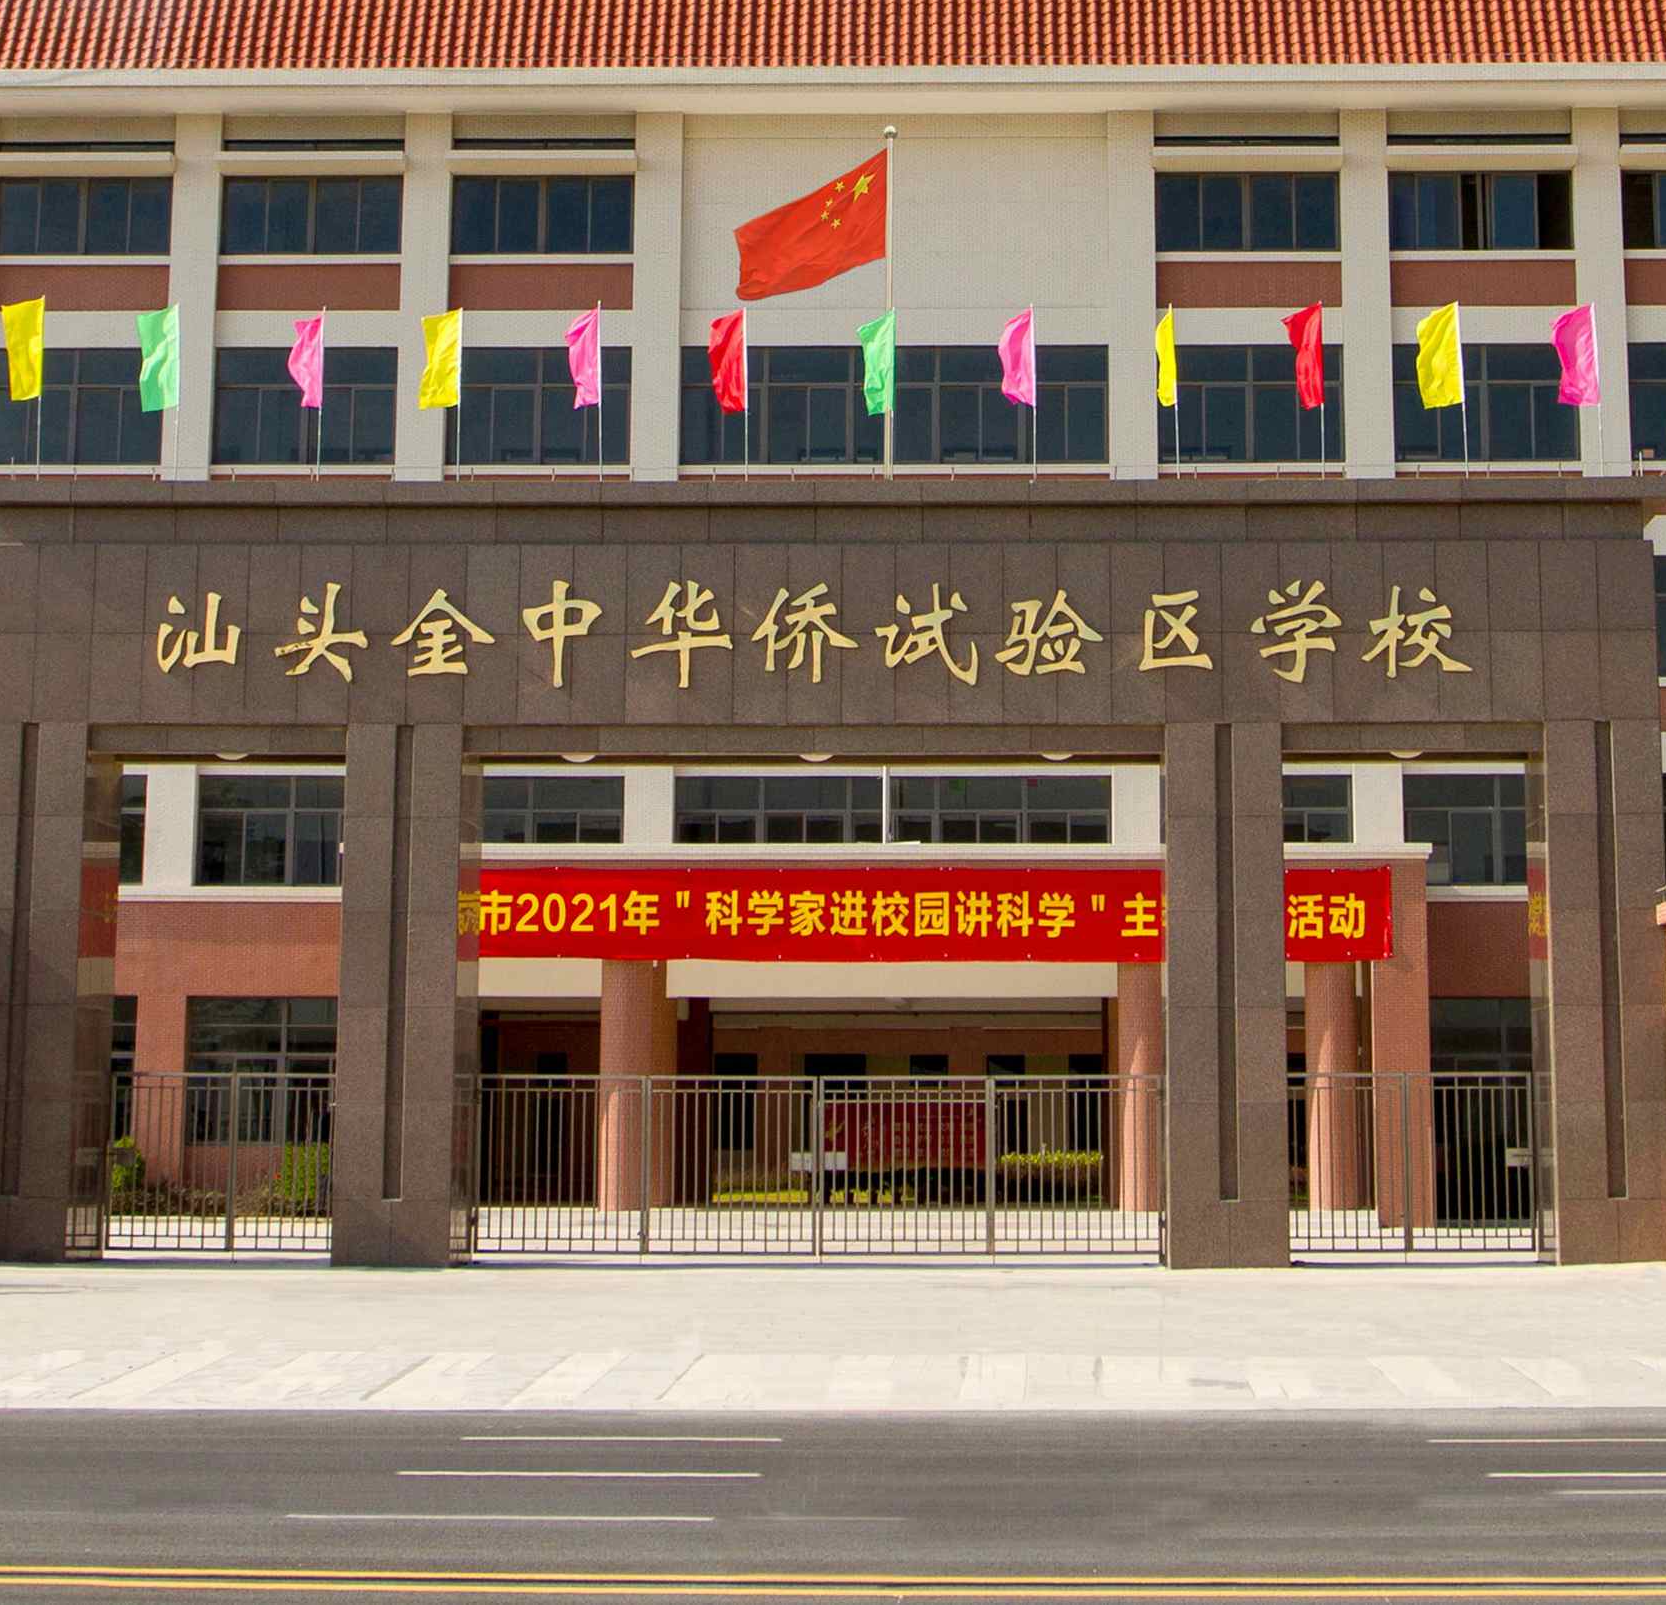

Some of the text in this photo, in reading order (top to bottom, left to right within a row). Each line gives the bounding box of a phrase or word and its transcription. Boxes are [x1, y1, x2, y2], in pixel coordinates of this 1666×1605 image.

[156, 580, 1473, 689] 汕头金中华侨试验区学校
[1288, 892, 1366, 939] 活动
